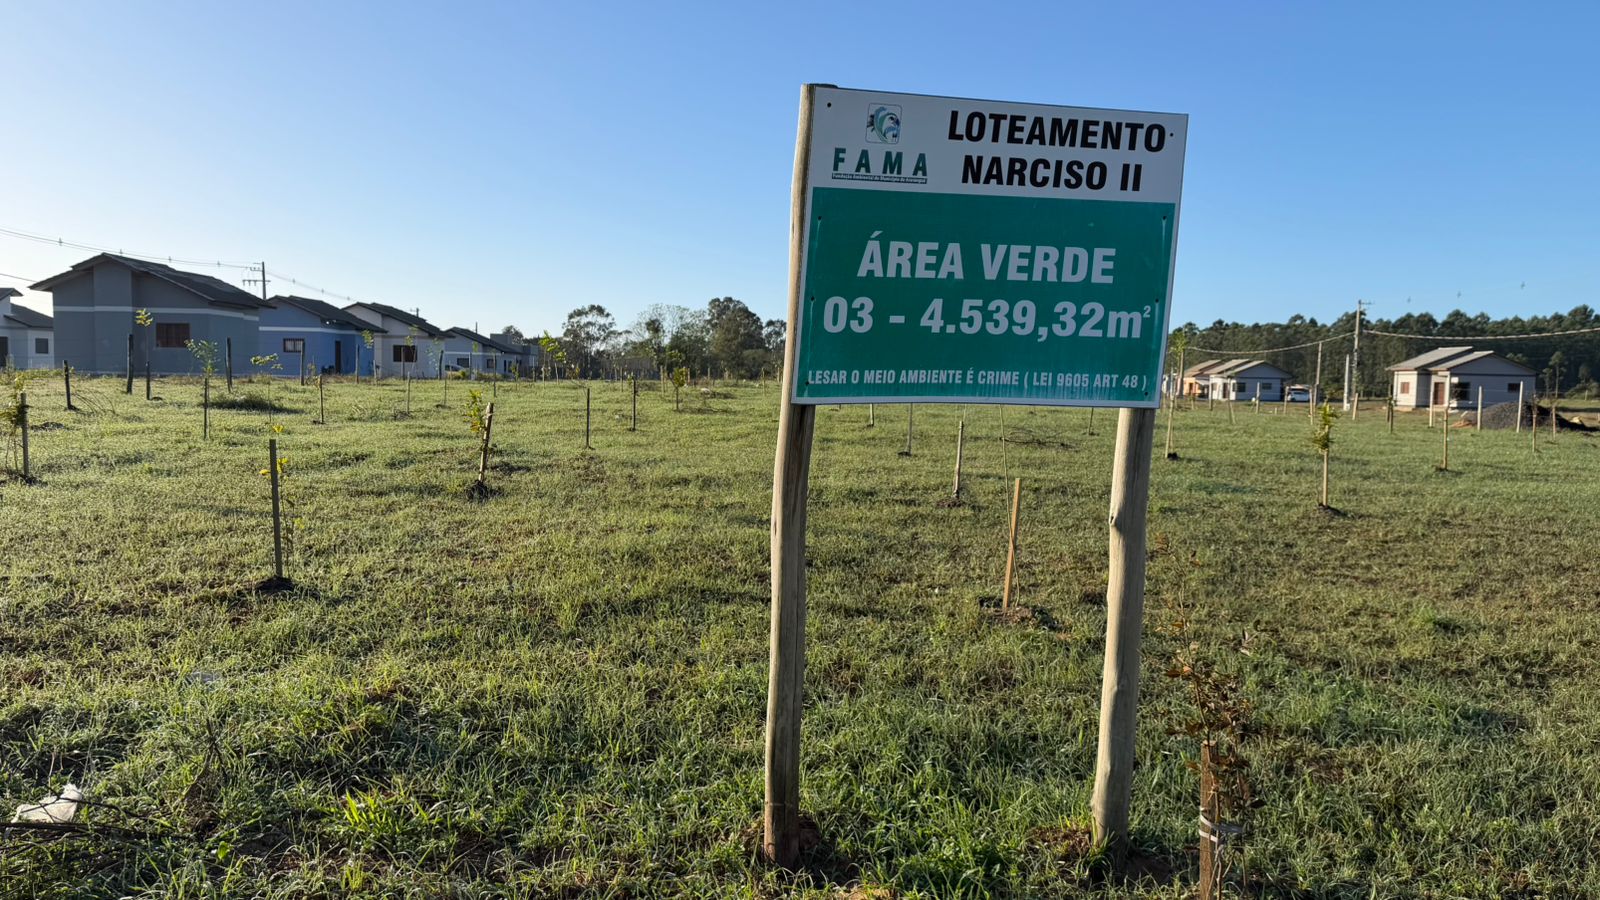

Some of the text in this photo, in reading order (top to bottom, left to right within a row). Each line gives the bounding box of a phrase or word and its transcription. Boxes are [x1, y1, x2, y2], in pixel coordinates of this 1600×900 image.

[948, 110, 1166, 152] LOTEAMENTO
[833, 147, 928, 177] FAMA
[961, 154, 1142, 191] NARCISO II
[857, 230, 1116, 283] ÁREA VERDE
[823, 296, 874, 333] 03
[808, 370, 847, 385] LESAR
[851, 370, 859, 384] O
[863, 369, 896, 384] MEIO
[899, 369, 962, 384] AMBIENTE
[966, 367, 974, 384] É
[978, 370, 1019, 385] CRIME
[1056, 373, 1089, 387] 9605
[1093, 373, 1119, 388] ART
